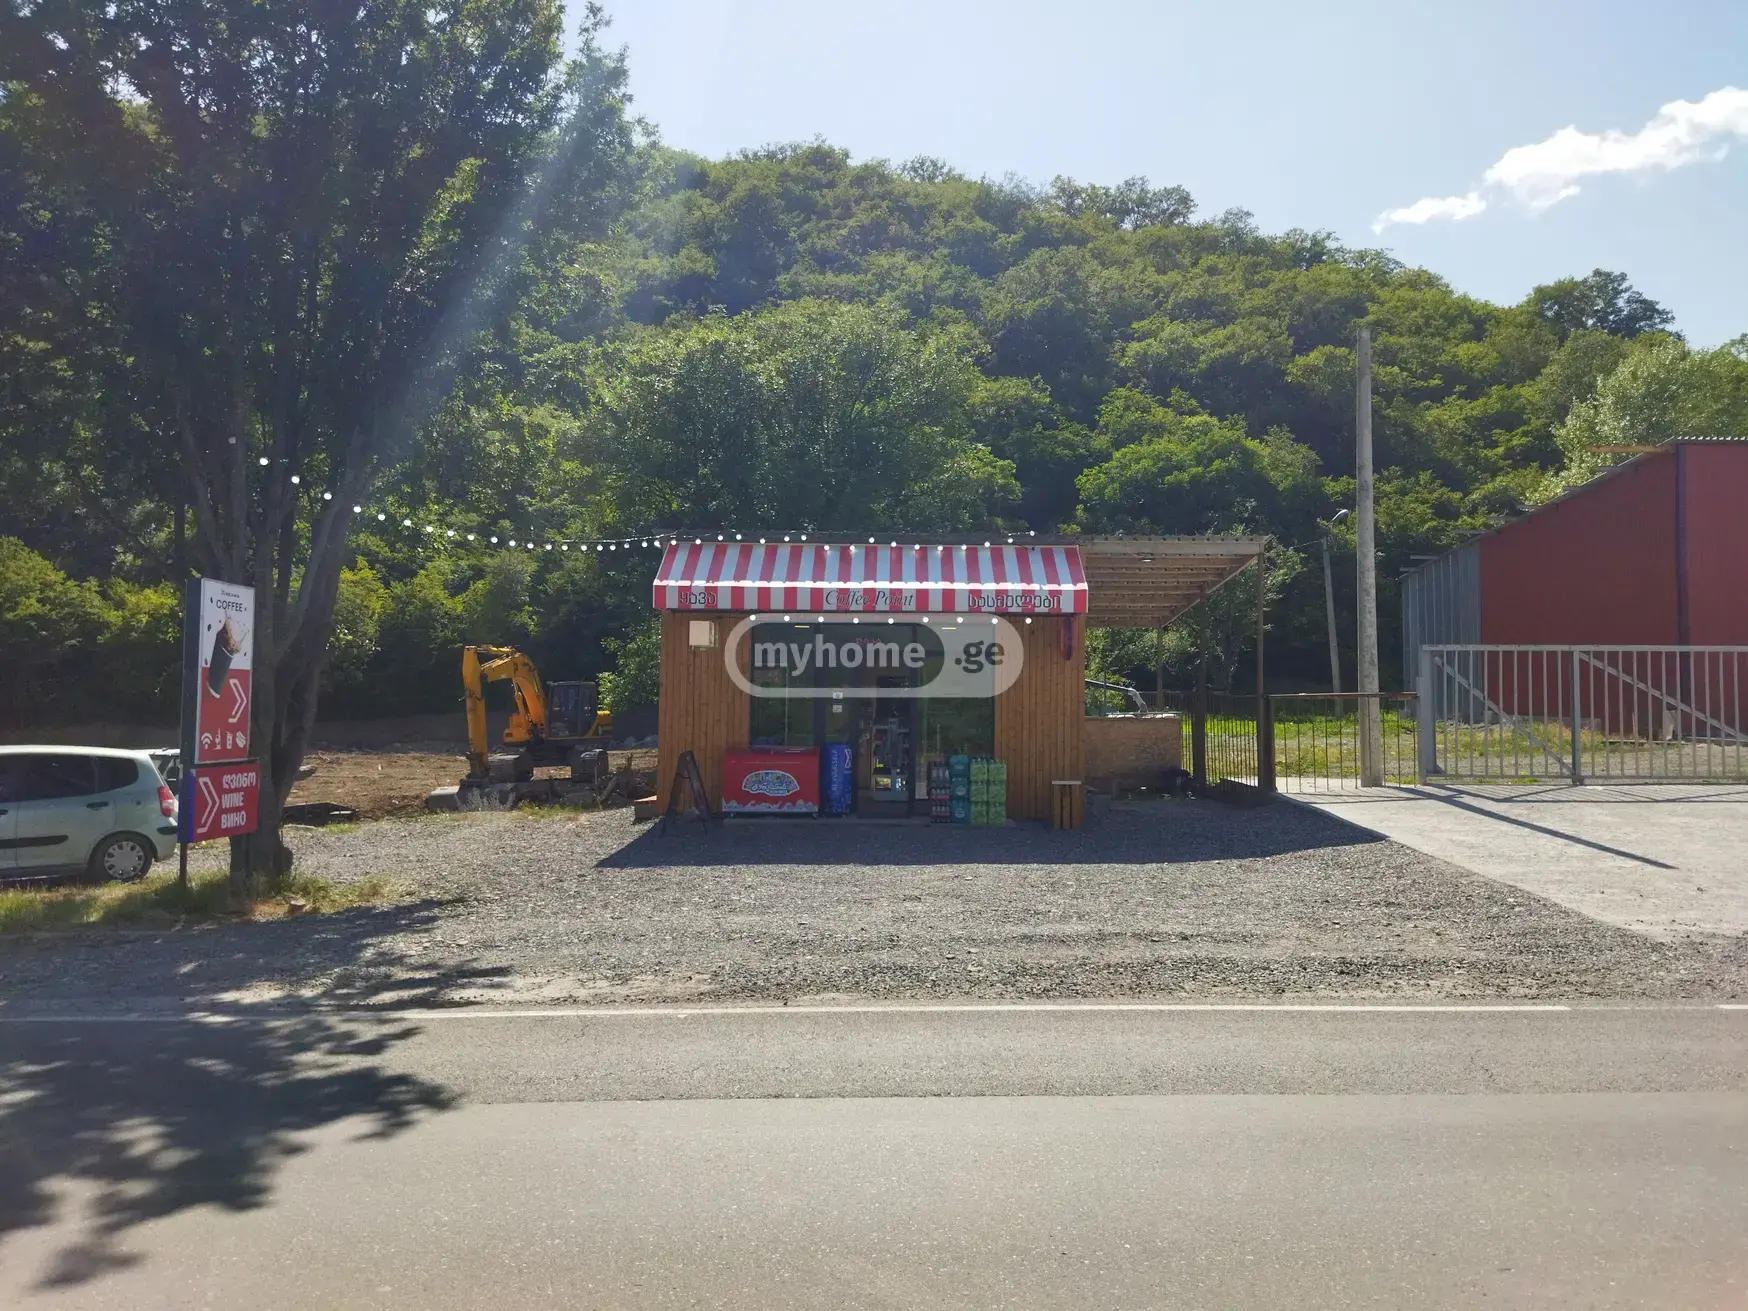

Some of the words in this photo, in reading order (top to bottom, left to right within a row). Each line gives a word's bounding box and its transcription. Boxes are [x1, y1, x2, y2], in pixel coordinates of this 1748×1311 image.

[216, 599, 243, 612] COFFEE
[680, 591, 717, 606] ყავა
[825, 590, 871, 608] Coffee
[875, 590, 914, 607] Point
[968, 593, 1062, 609] სასმელები
[223, 772, 256, 789] ღვინო
[222, 791, 245, 809] WINE
[221, 811, 246, 829] ВИНО
